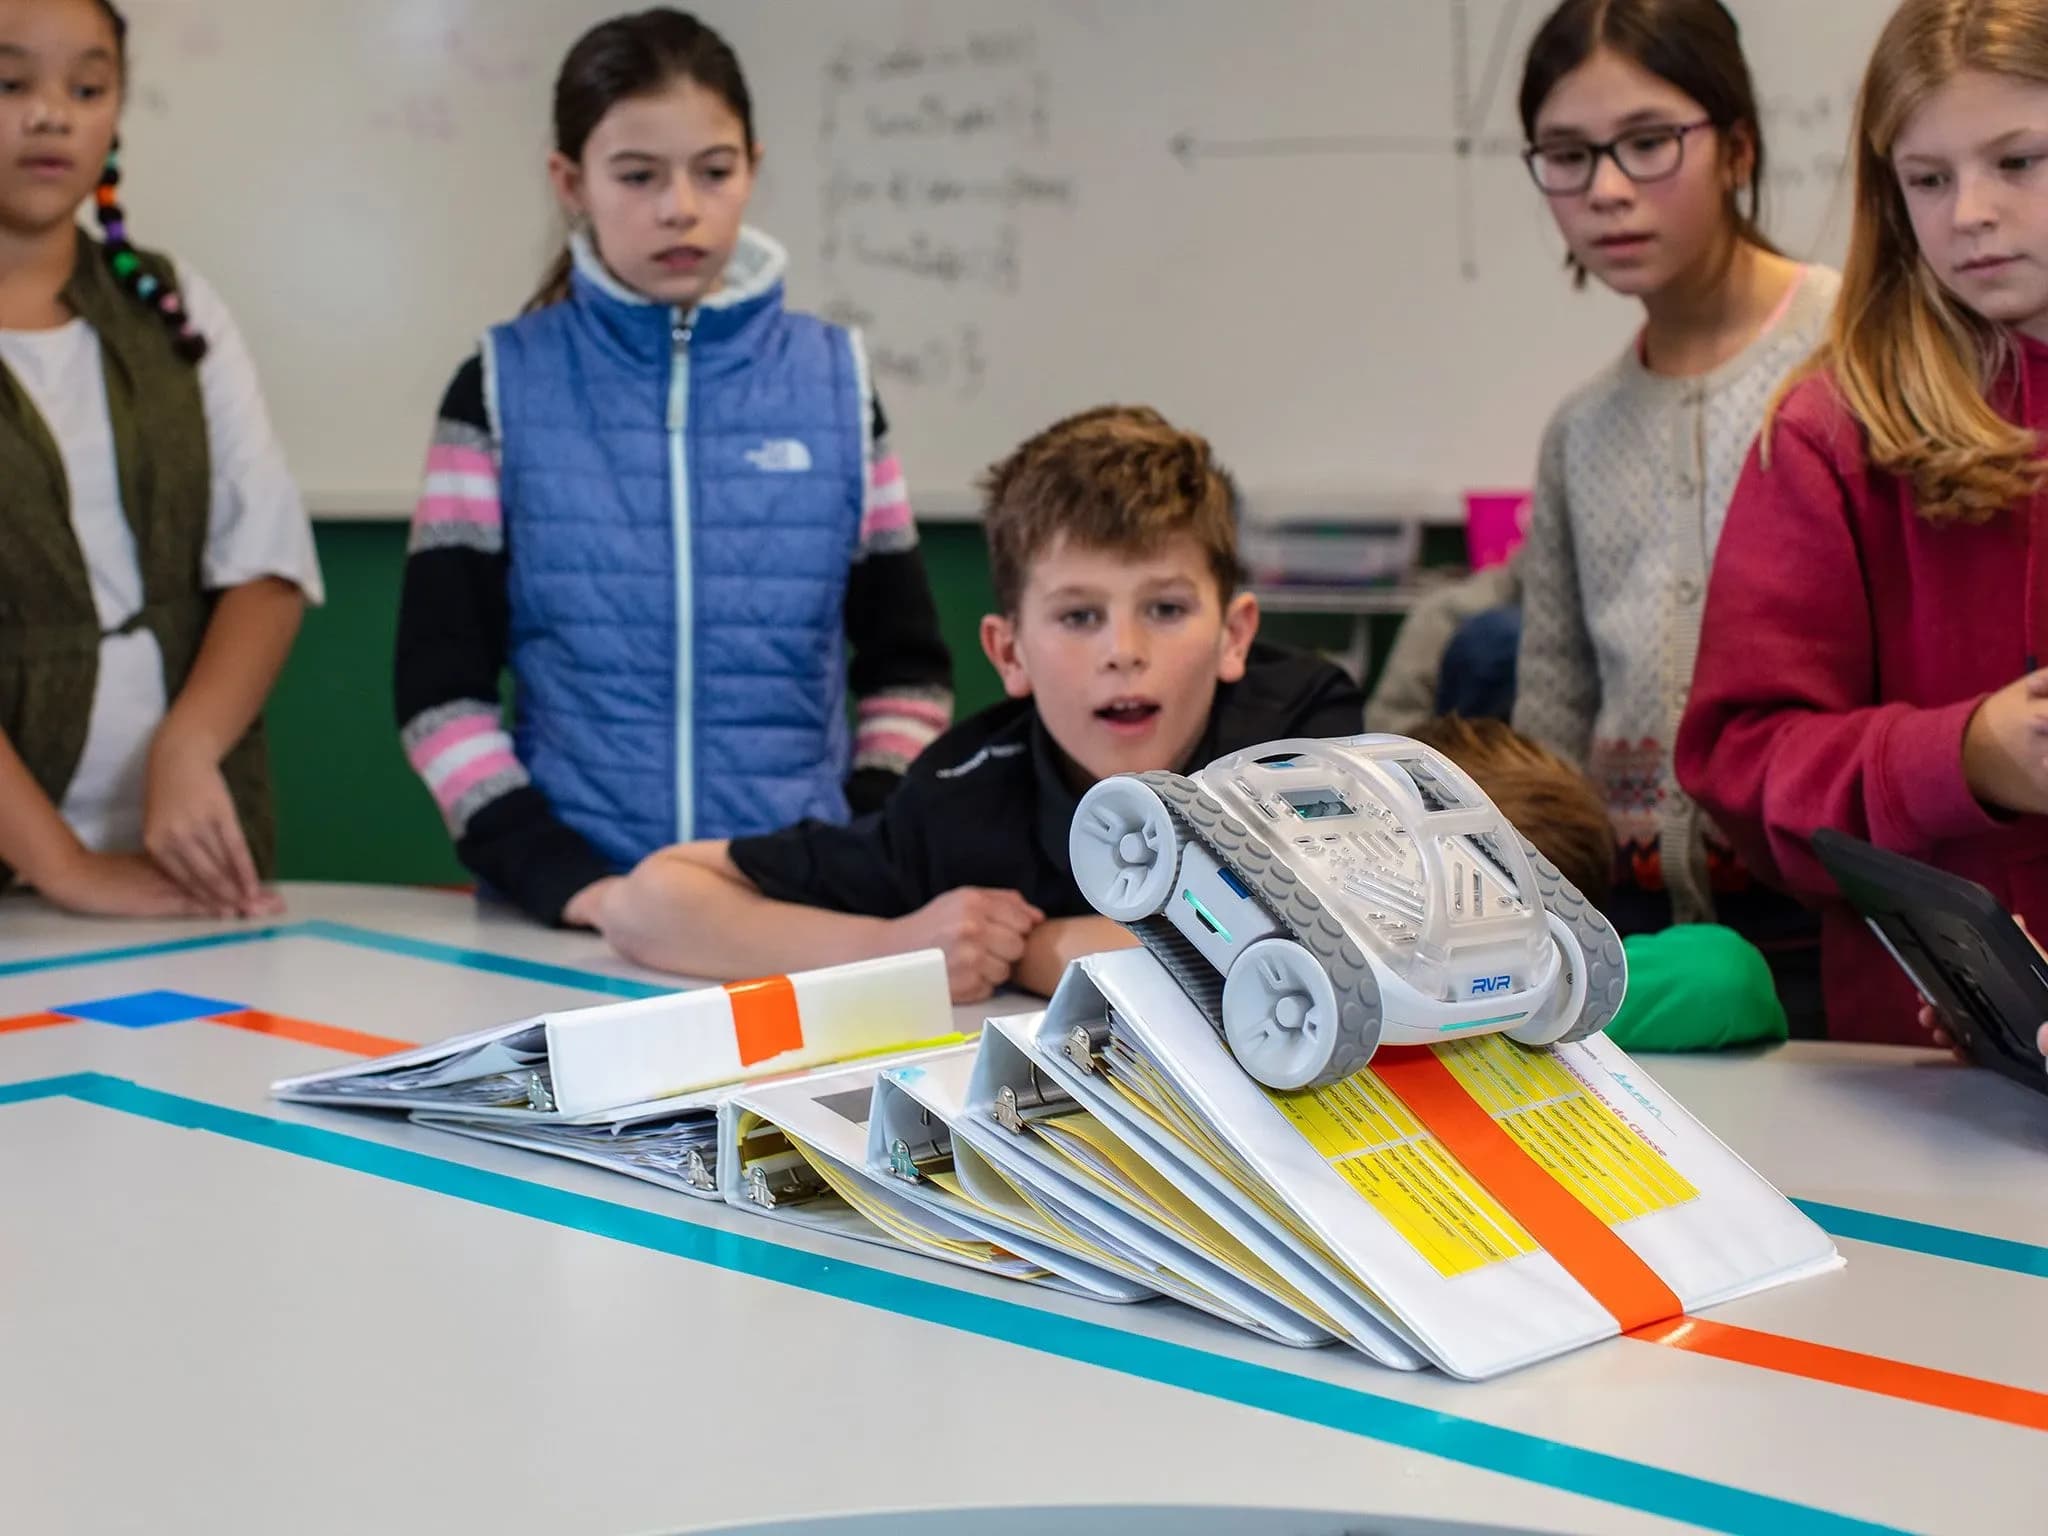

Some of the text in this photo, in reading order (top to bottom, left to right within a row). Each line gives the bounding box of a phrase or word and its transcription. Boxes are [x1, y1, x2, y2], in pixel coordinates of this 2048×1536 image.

[1472, 975, 1511, 994] RVR
[1545, 1043, 1668, 1157] xpressions de Classe
